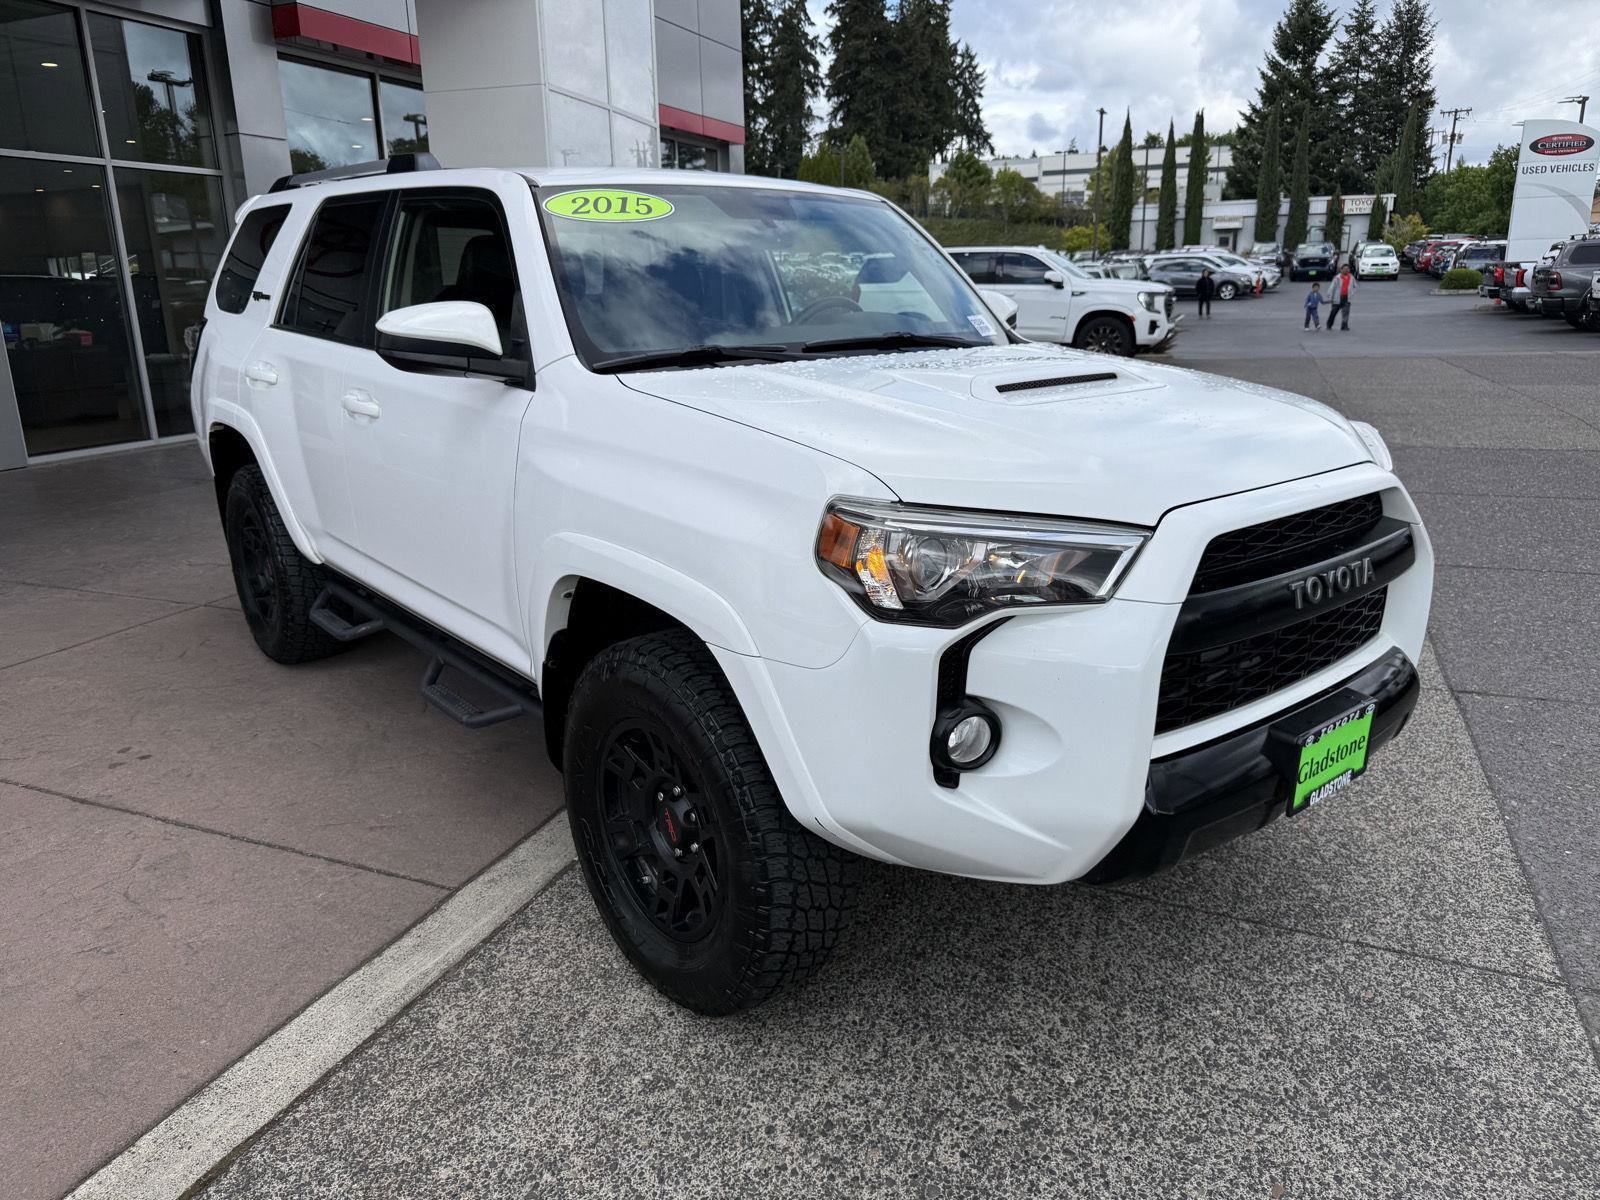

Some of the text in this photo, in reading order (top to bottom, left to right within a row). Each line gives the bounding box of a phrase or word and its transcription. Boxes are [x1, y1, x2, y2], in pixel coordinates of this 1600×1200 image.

[1538, 140, 1587, 149] CERTIFIED
[1522, 163, 1595, 175] USED VEHICLES
[571, 196, 653, 215] 2015
[1289, 557, 1376, 610] TOYOTA
[1319, 710, 1361, 738] TOYOTA
[1298, 735, 1366, 785] Gladstone
[1310, 769, 1352, 806] GLADSTONE
